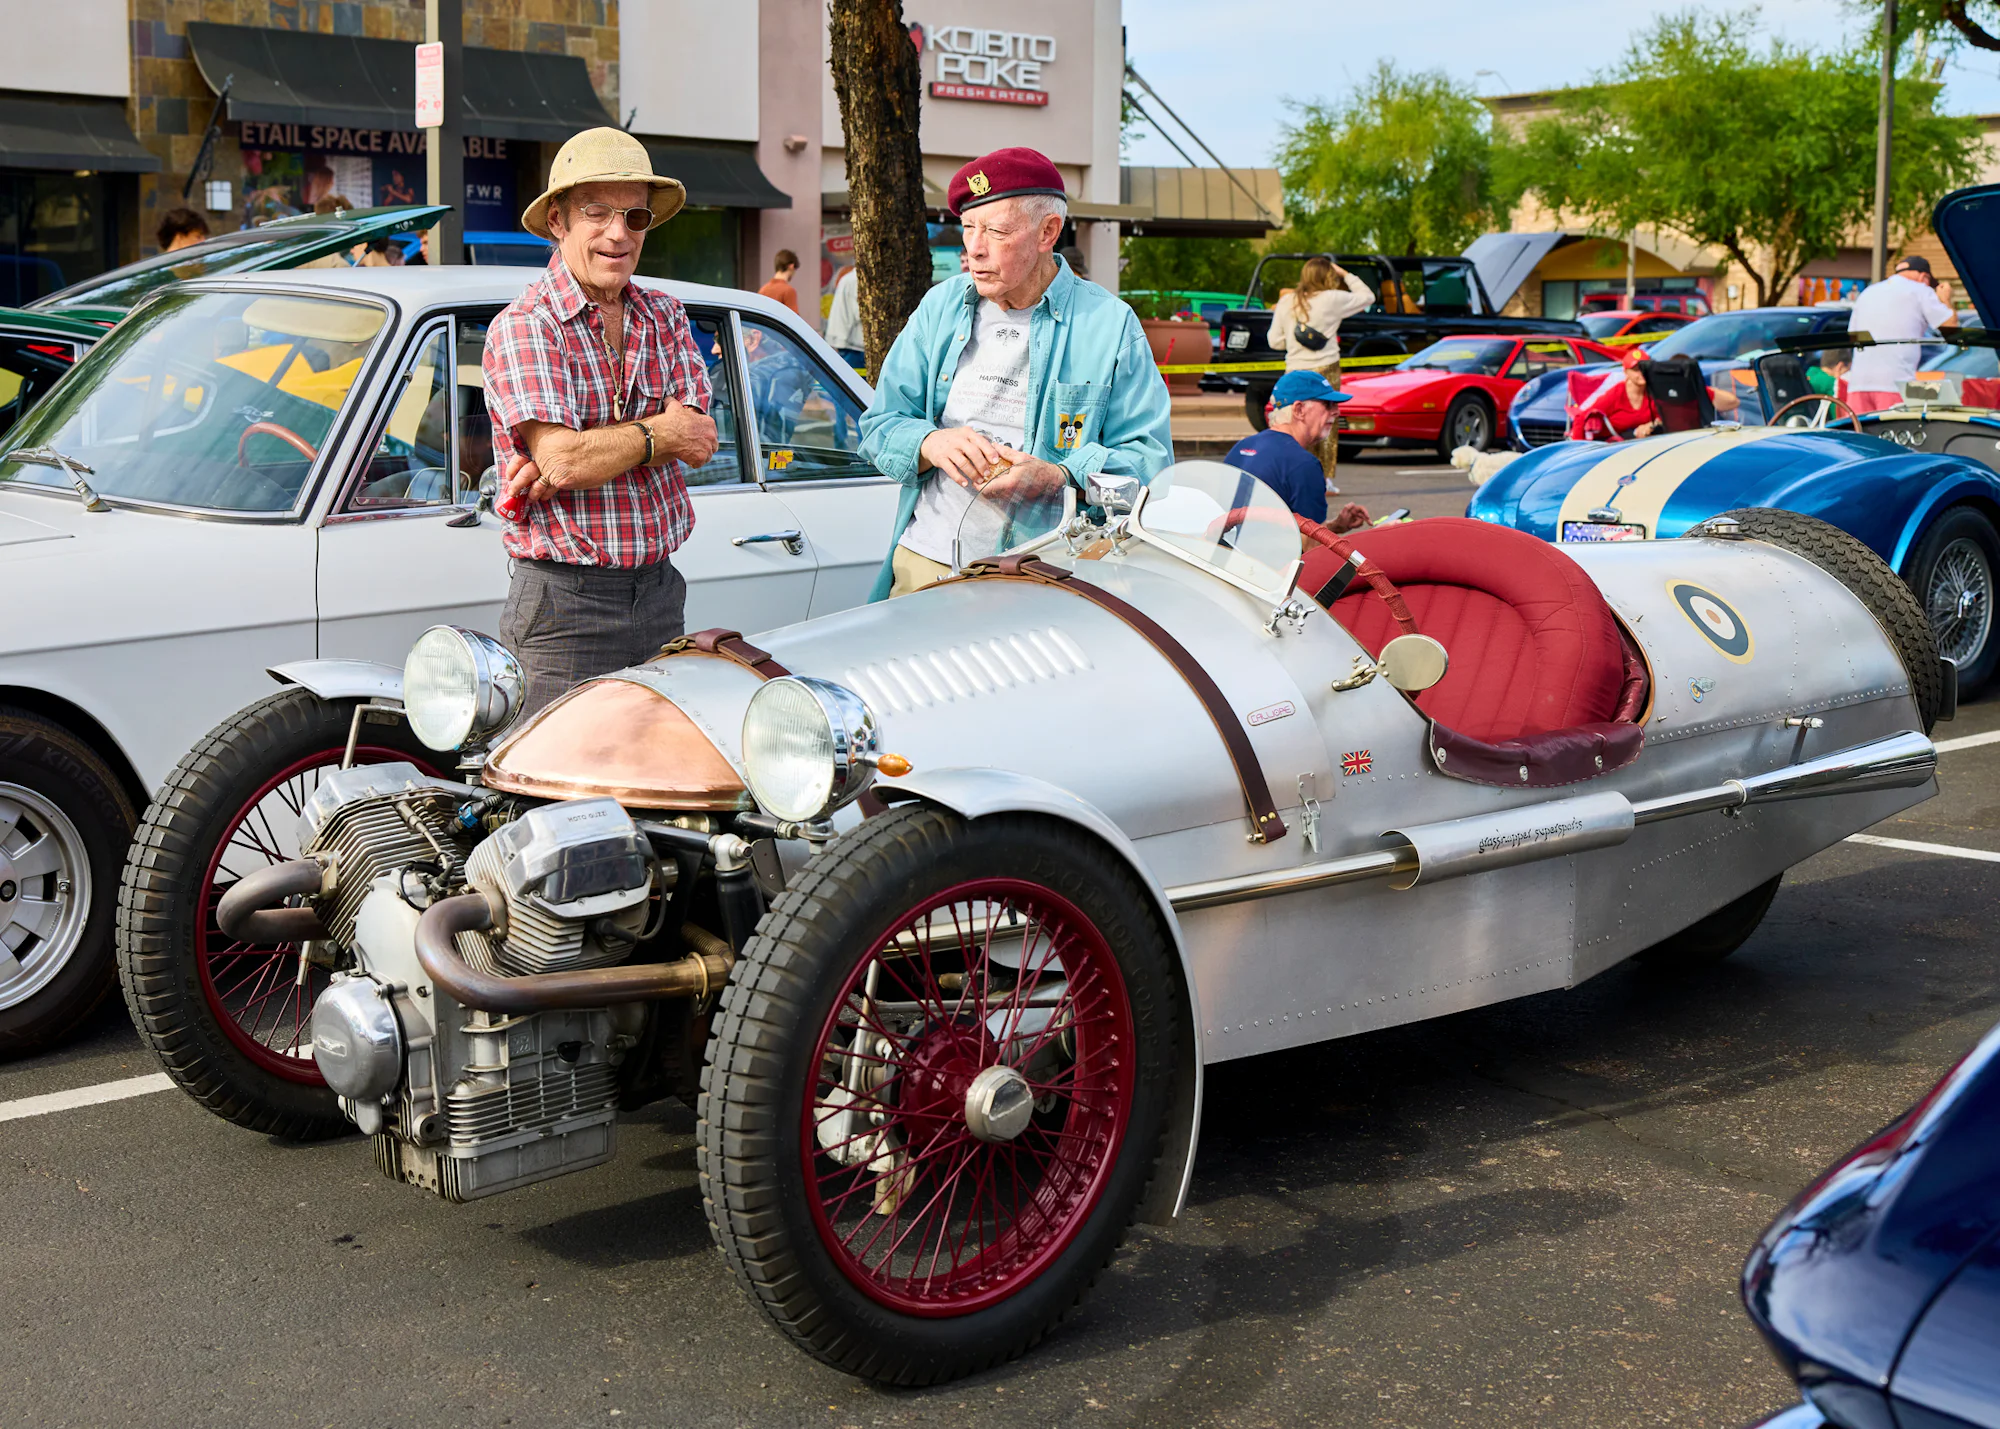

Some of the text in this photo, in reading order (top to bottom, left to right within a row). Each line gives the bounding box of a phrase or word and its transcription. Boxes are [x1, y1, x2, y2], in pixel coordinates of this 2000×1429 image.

[927, 25, 1056, 62] KOIBITO
[937, 53, 1041, 90] POKE
[936, 85, 1044, 102] FRESH EATERY
[311, 127, 382, 151] SPACE
[979, 374, 1019, 388] HAPPINESS
[1250, 705, 1291, 723] CALLIOPE
